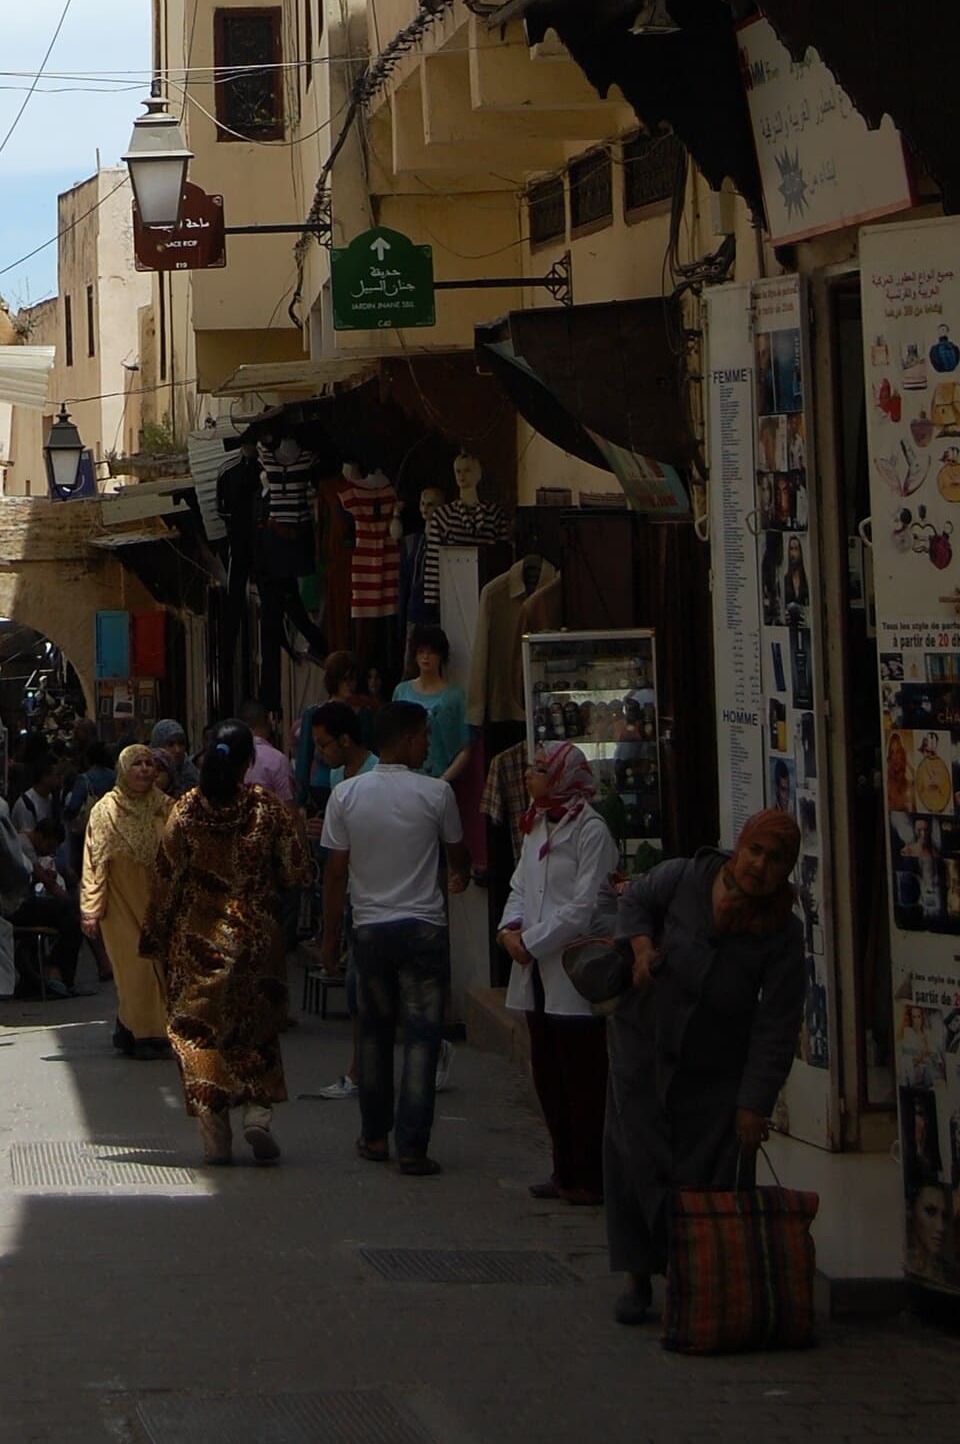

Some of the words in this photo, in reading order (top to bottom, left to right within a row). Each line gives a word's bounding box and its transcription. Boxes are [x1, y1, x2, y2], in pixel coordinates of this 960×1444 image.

[713, 368, 748, 385] FEMME
[900, 634, 923, 651] partir
[925, 633, 936, 647] de
[938, 633, 950, 647] 20
[723, 710, 759, 726] HOMME
